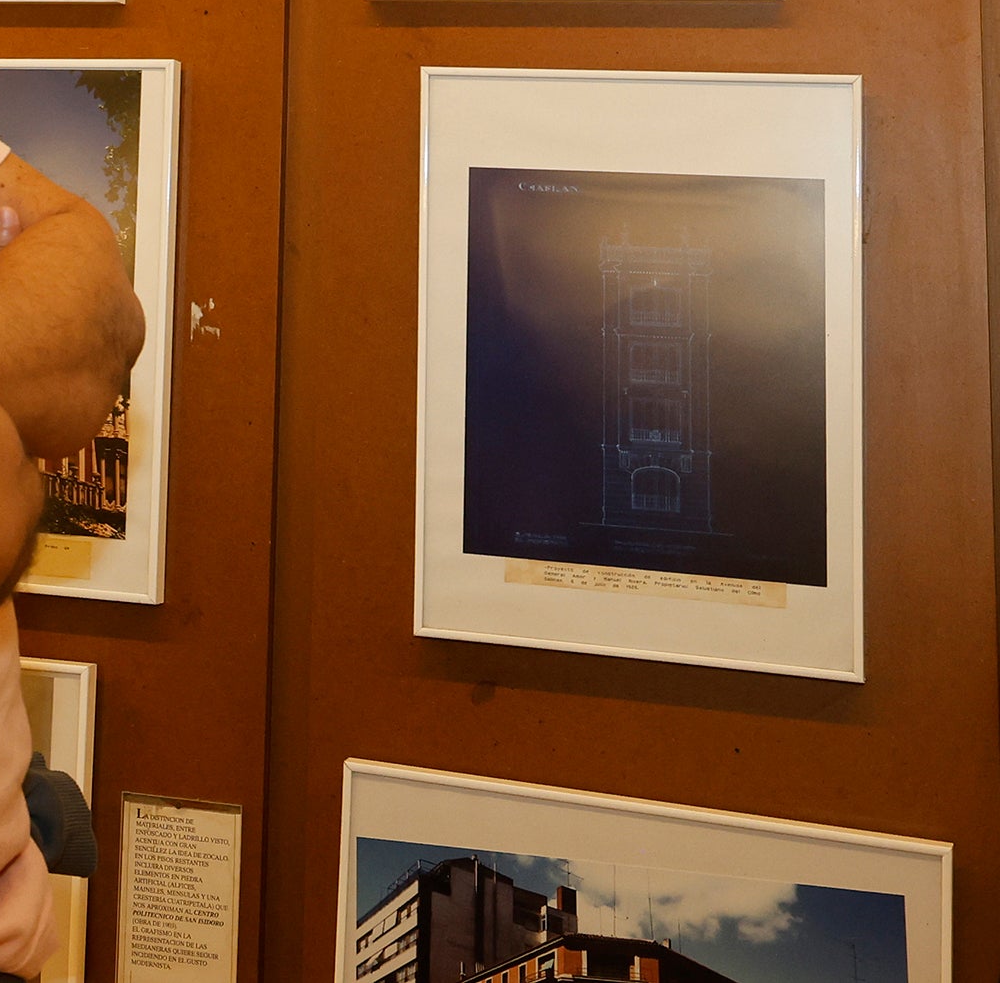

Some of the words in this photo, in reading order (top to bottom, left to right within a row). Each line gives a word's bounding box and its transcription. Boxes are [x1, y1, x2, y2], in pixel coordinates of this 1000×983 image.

[150, 814, 184, 824] DISTINCION
[176, 825, 196, 833] ENTRE
[136, 828, 172, 839] ENFOSCADO
[179, 833, 209, 843] LADRILLO
[210, 837, 230, 846] VISTO,
[135, 836, 164, 846] ACENTUA
[165, 840, 178, 848] CON
[179, 842, 197, 850] GRAN
[178, 850, 192, 858] IDEA
[144, 854, 156, 862] LOS
[157, 856, 174, 864] PISOS
[175, 858, 210, 868] RESTANTES
[165, 865, 193, 874] DIVERSOS
[134, 870, 170, 880] ELEMENTOS
[181, 875, 203, 884] PIEDRA
[134, 878, 166, 887] ARTIFICIAL
[167, 890, 200, 900] MENSULAS
[147, 904, 183, 914] APROXIMAN
[194, 909, 219, 918] CENTRO
[133, 910, 174, 920] POLITECNICO
[198, 918, 224, 927] ISIDORO
[141, 927, 172, 937] GRAFISMO
[132, 934, 185, 946] REPRESENTACION
[132, 942, 172, 952] MEDIANERAS
